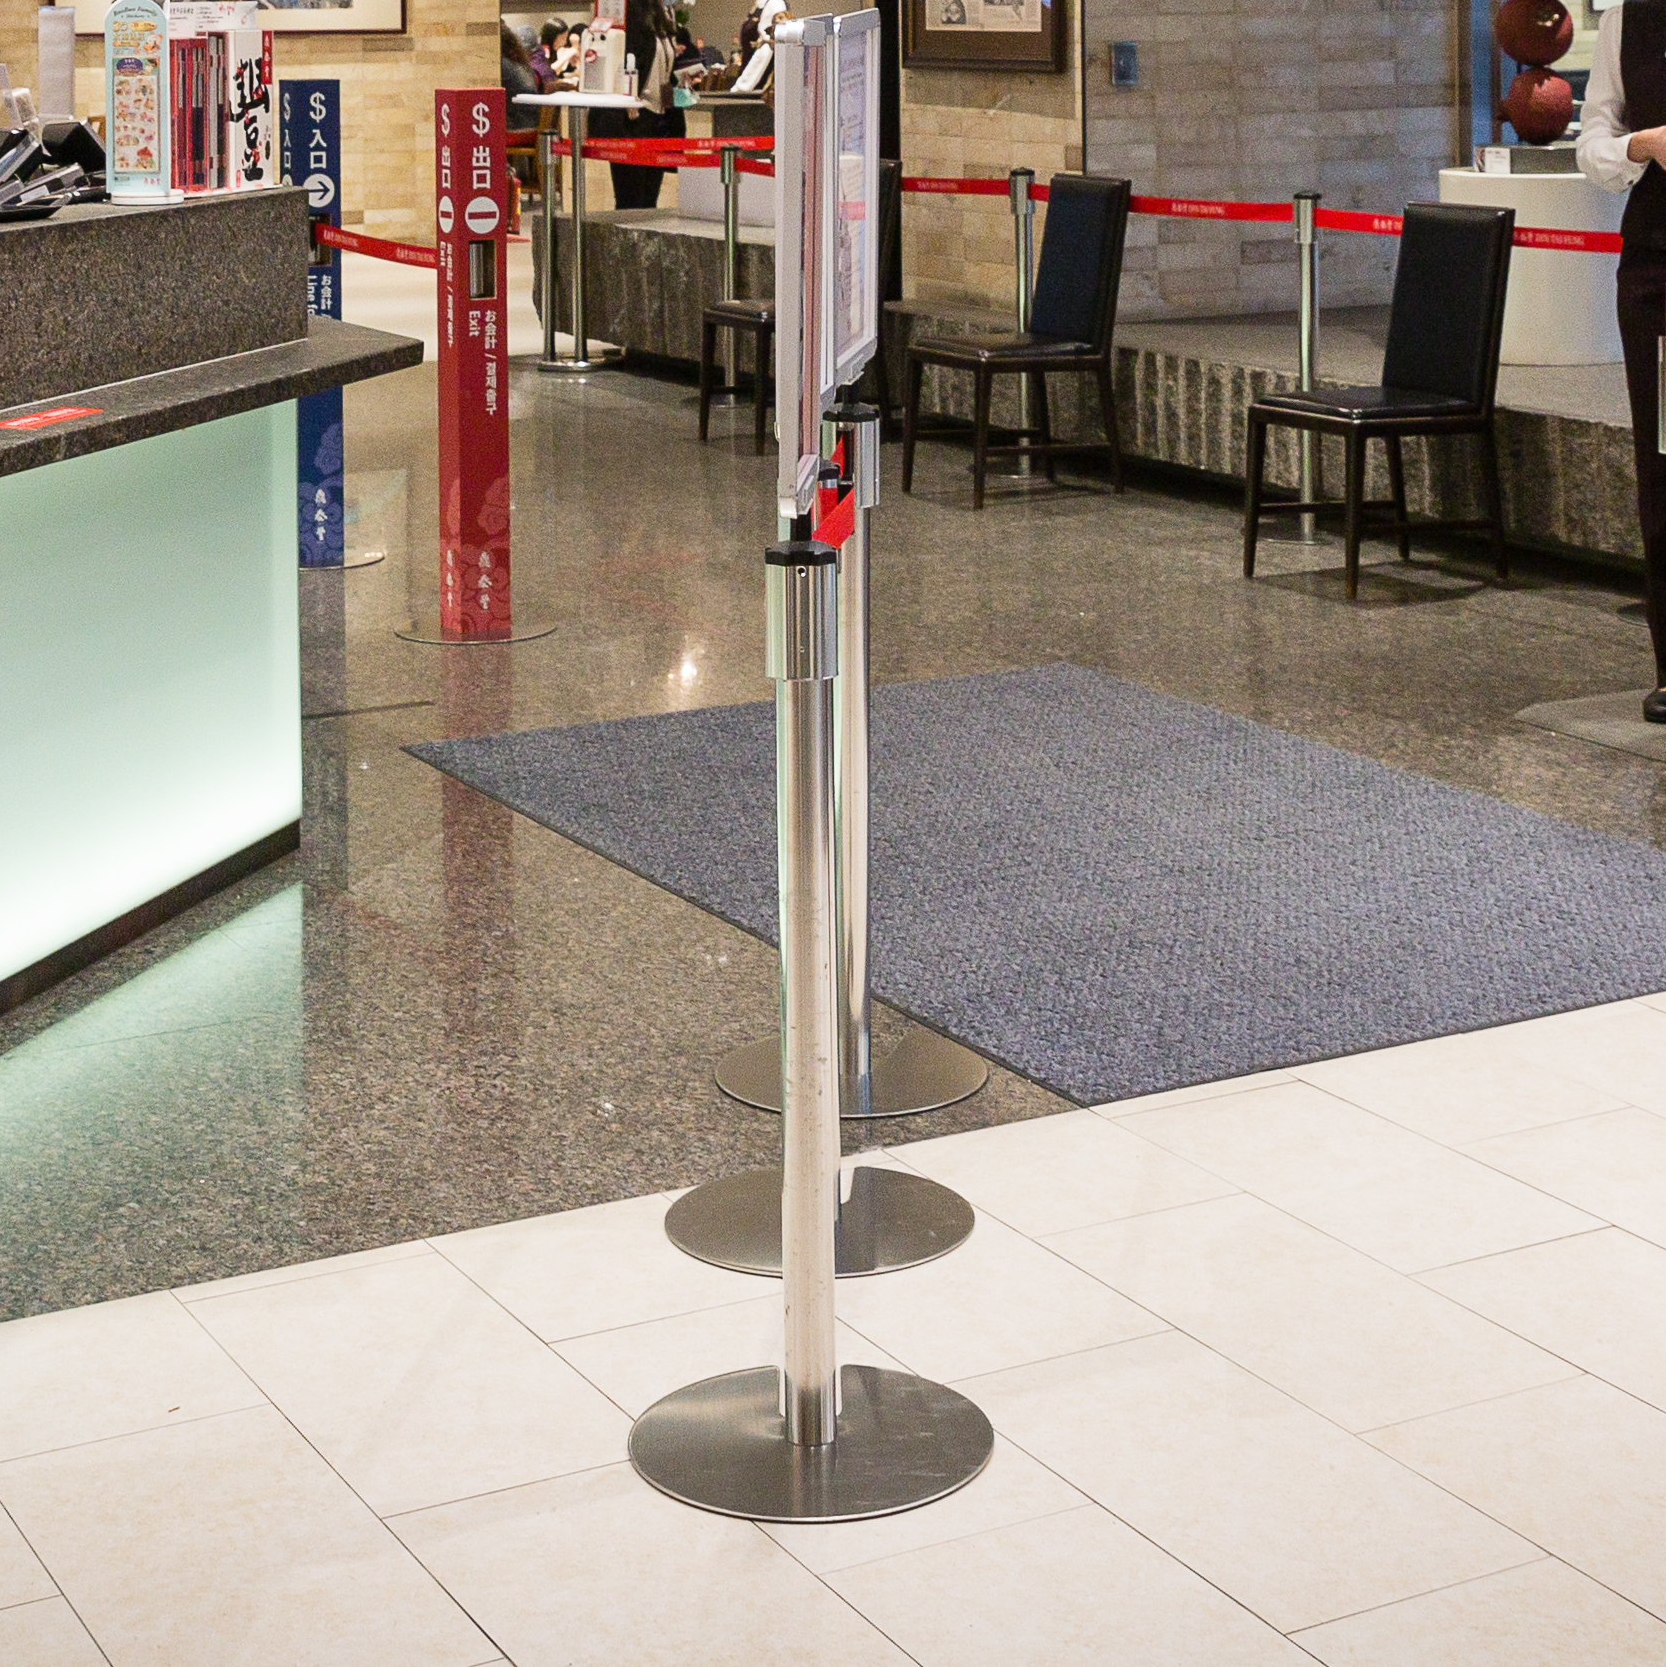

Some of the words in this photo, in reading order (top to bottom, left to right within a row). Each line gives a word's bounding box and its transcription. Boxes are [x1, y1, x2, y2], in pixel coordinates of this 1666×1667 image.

[309, 91, 327, 123] $
[472, 102, 491, 138] $
[284, 130, 292, 169] 入口
[309, 129, 327, 169] 入口
[441, 145, 451, 189] 出口
[472, 145, 491, 190] 出口
[321, 274, 333, 310] お会計
[469, 310, 481, 337] Exit
[477, 551, 493, 610] 鼎泰豐
